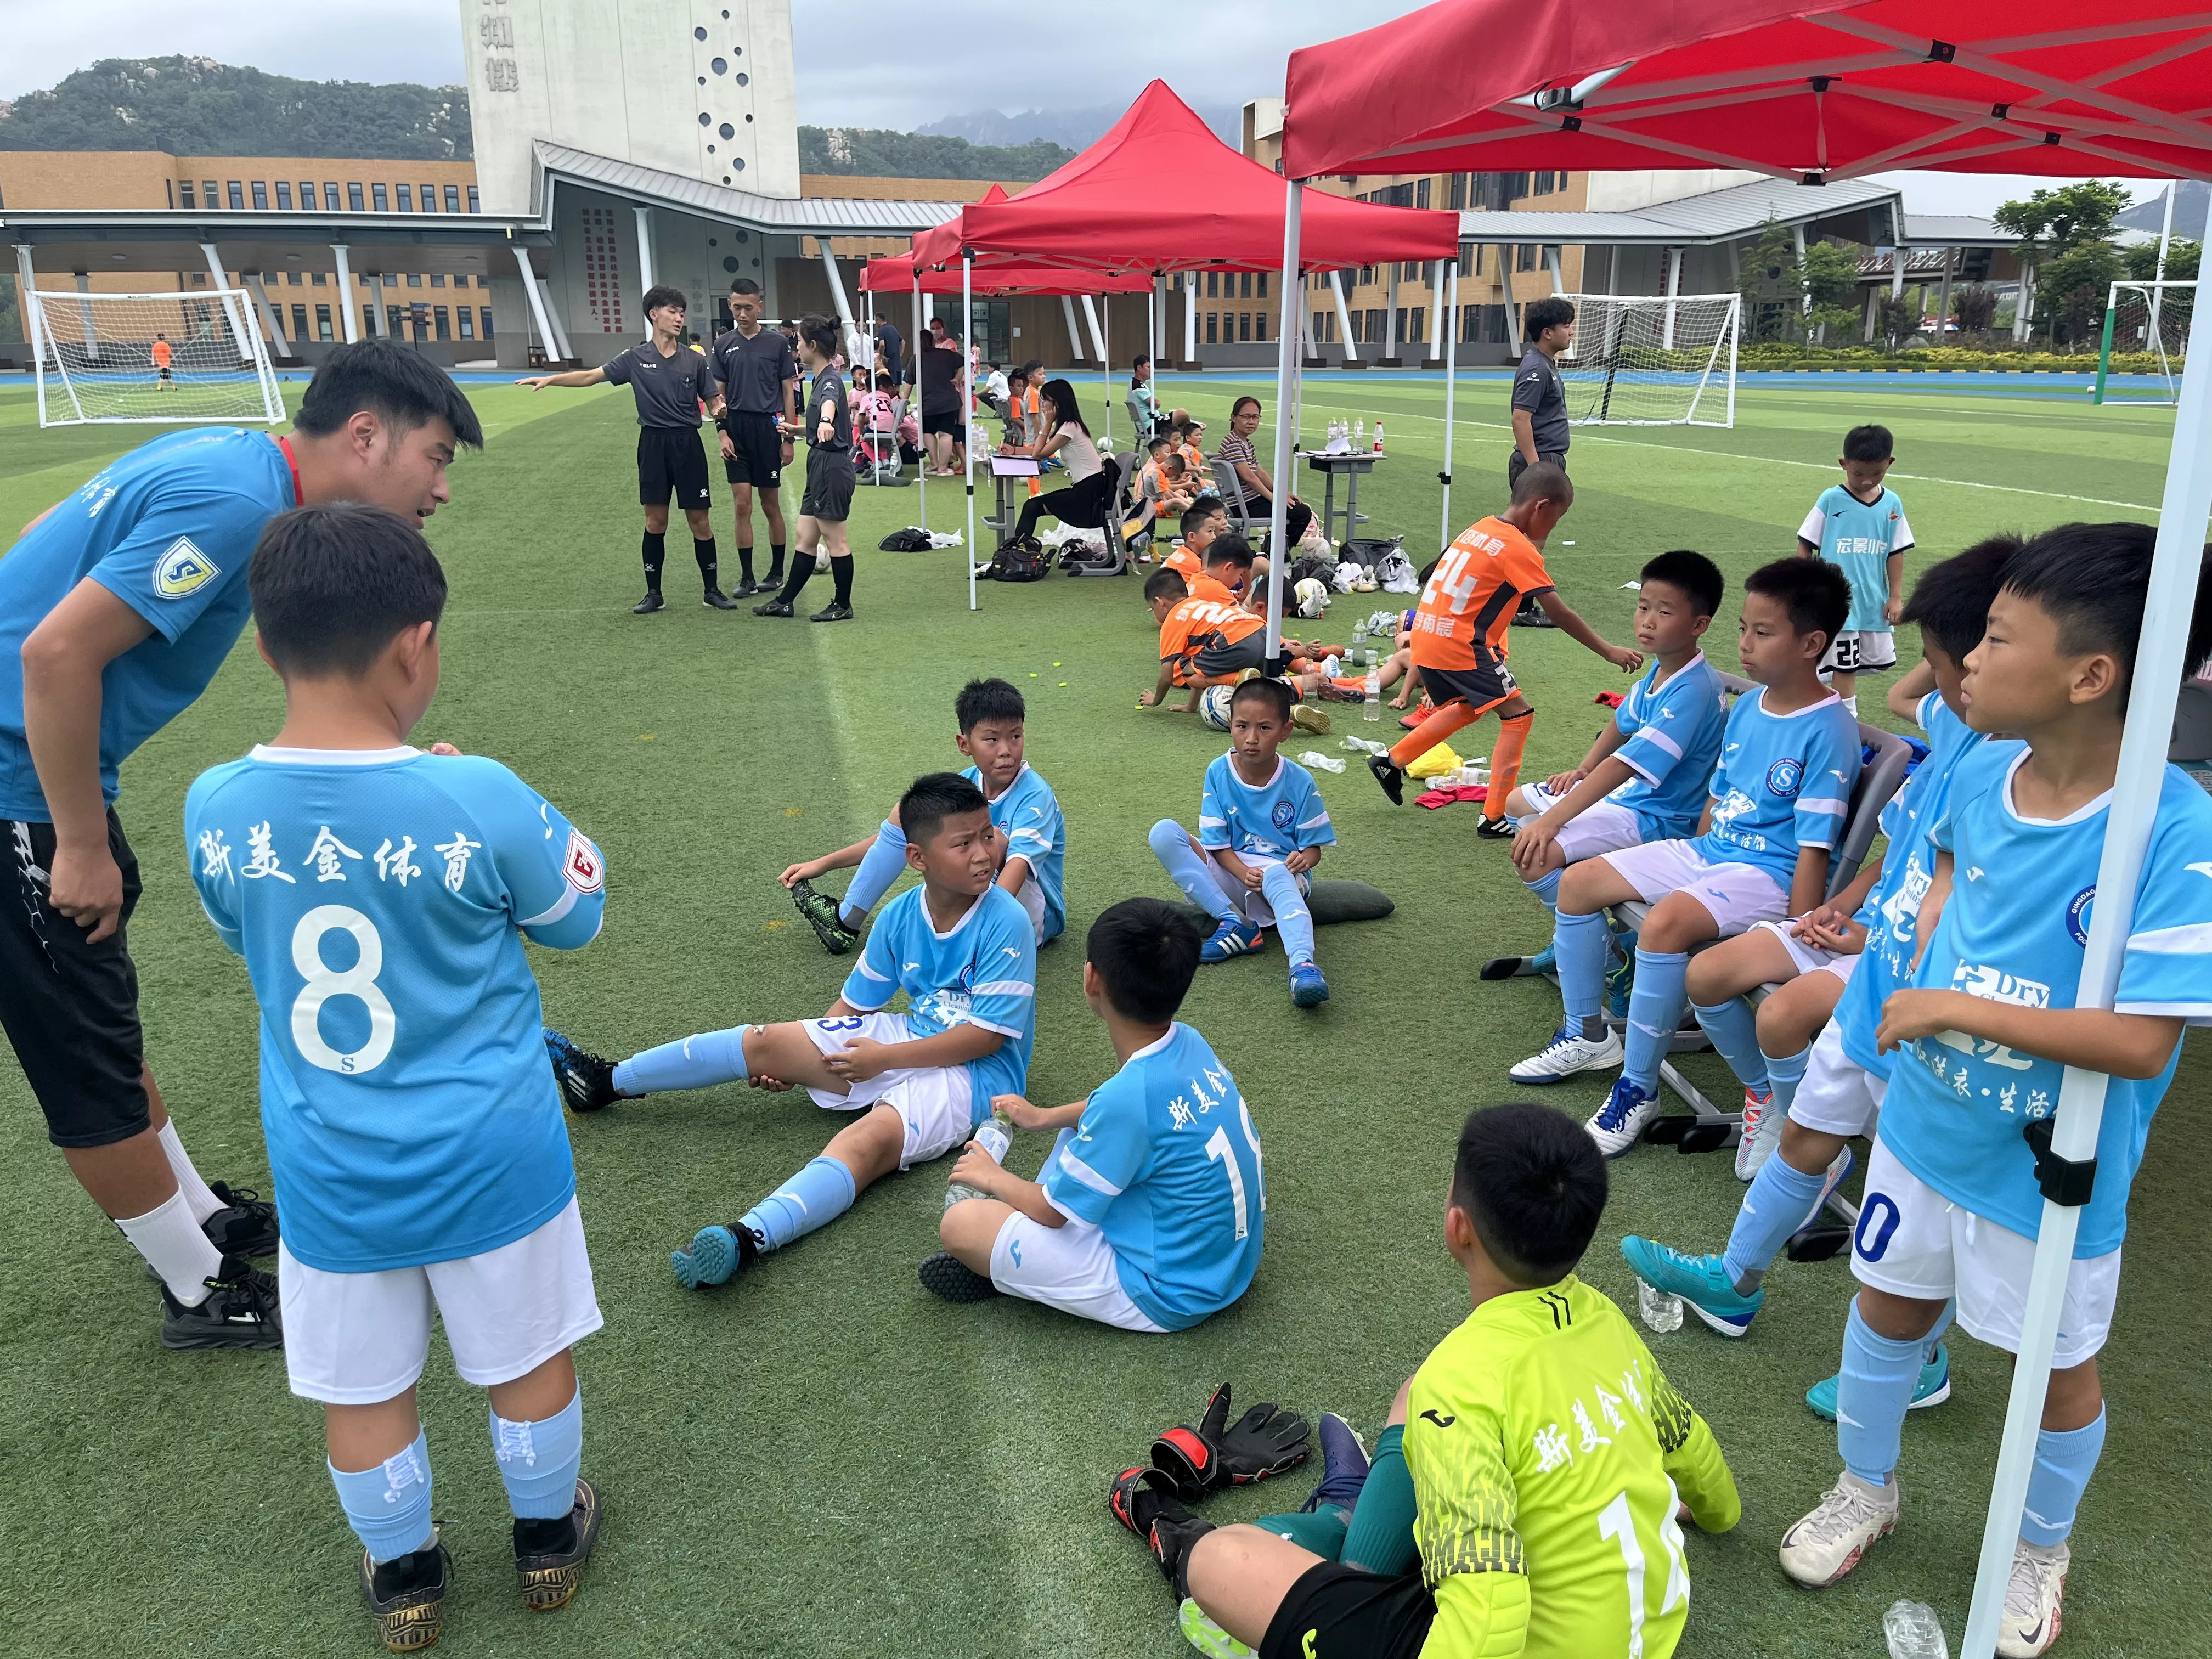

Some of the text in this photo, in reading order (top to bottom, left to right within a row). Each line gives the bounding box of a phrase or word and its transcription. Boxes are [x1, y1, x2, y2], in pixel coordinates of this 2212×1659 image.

[480, 0, 518, 92] 知楼
[1422, 548, 1478, 615] 24
[200, 820, 481, 892] 斯美金体育
[2071, 889, 2096, 913] QINGDAO
[291, 904, 396, 1075] 8
[1994, 974, 2051, 1008] Dry
[817, 1018, 863, 1031] 3
[341, 1057, 355, 1072] S
[1855, 1192, 1900, 1262] 0
[1533, 1359, 1644, 1472] 斯美金体
